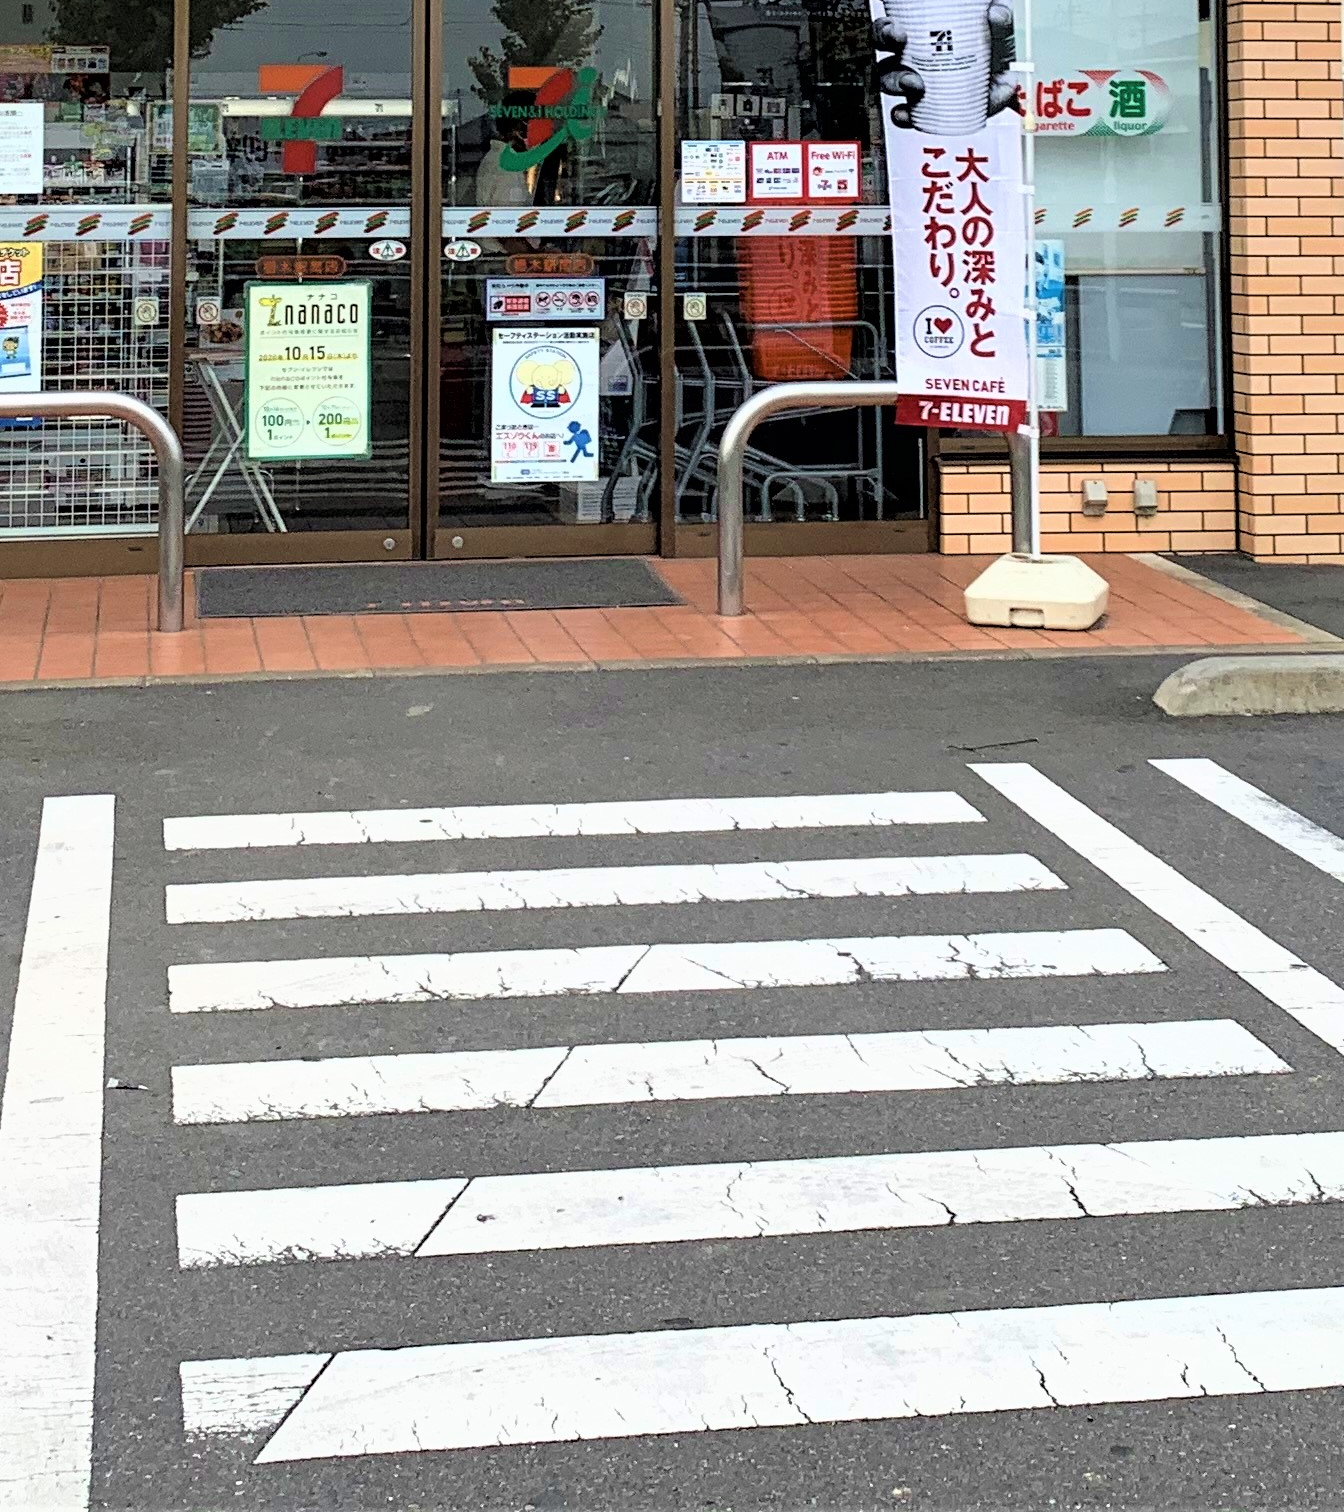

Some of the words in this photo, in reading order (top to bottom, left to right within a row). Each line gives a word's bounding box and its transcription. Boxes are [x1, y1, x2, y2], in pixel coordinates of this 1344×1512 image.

[1109, 80, 1146, 118] 酒
[1114, 121, 1147, 131] liquor
[766, 152, 788, 160] ATM
[811, 151, 830, 160] Free
[833, 151, 855, 160] Wi-Fi
[921, 148, 960, 299] こだわり。
[955, 148, 996, 357] 大人の深みと
[284, 303, 359, 325] nanaco
[924, 336, 954, 344] COFFEE
[925, 378, 969, 391] SEVEN
[535, 391, 555, 400] SS
